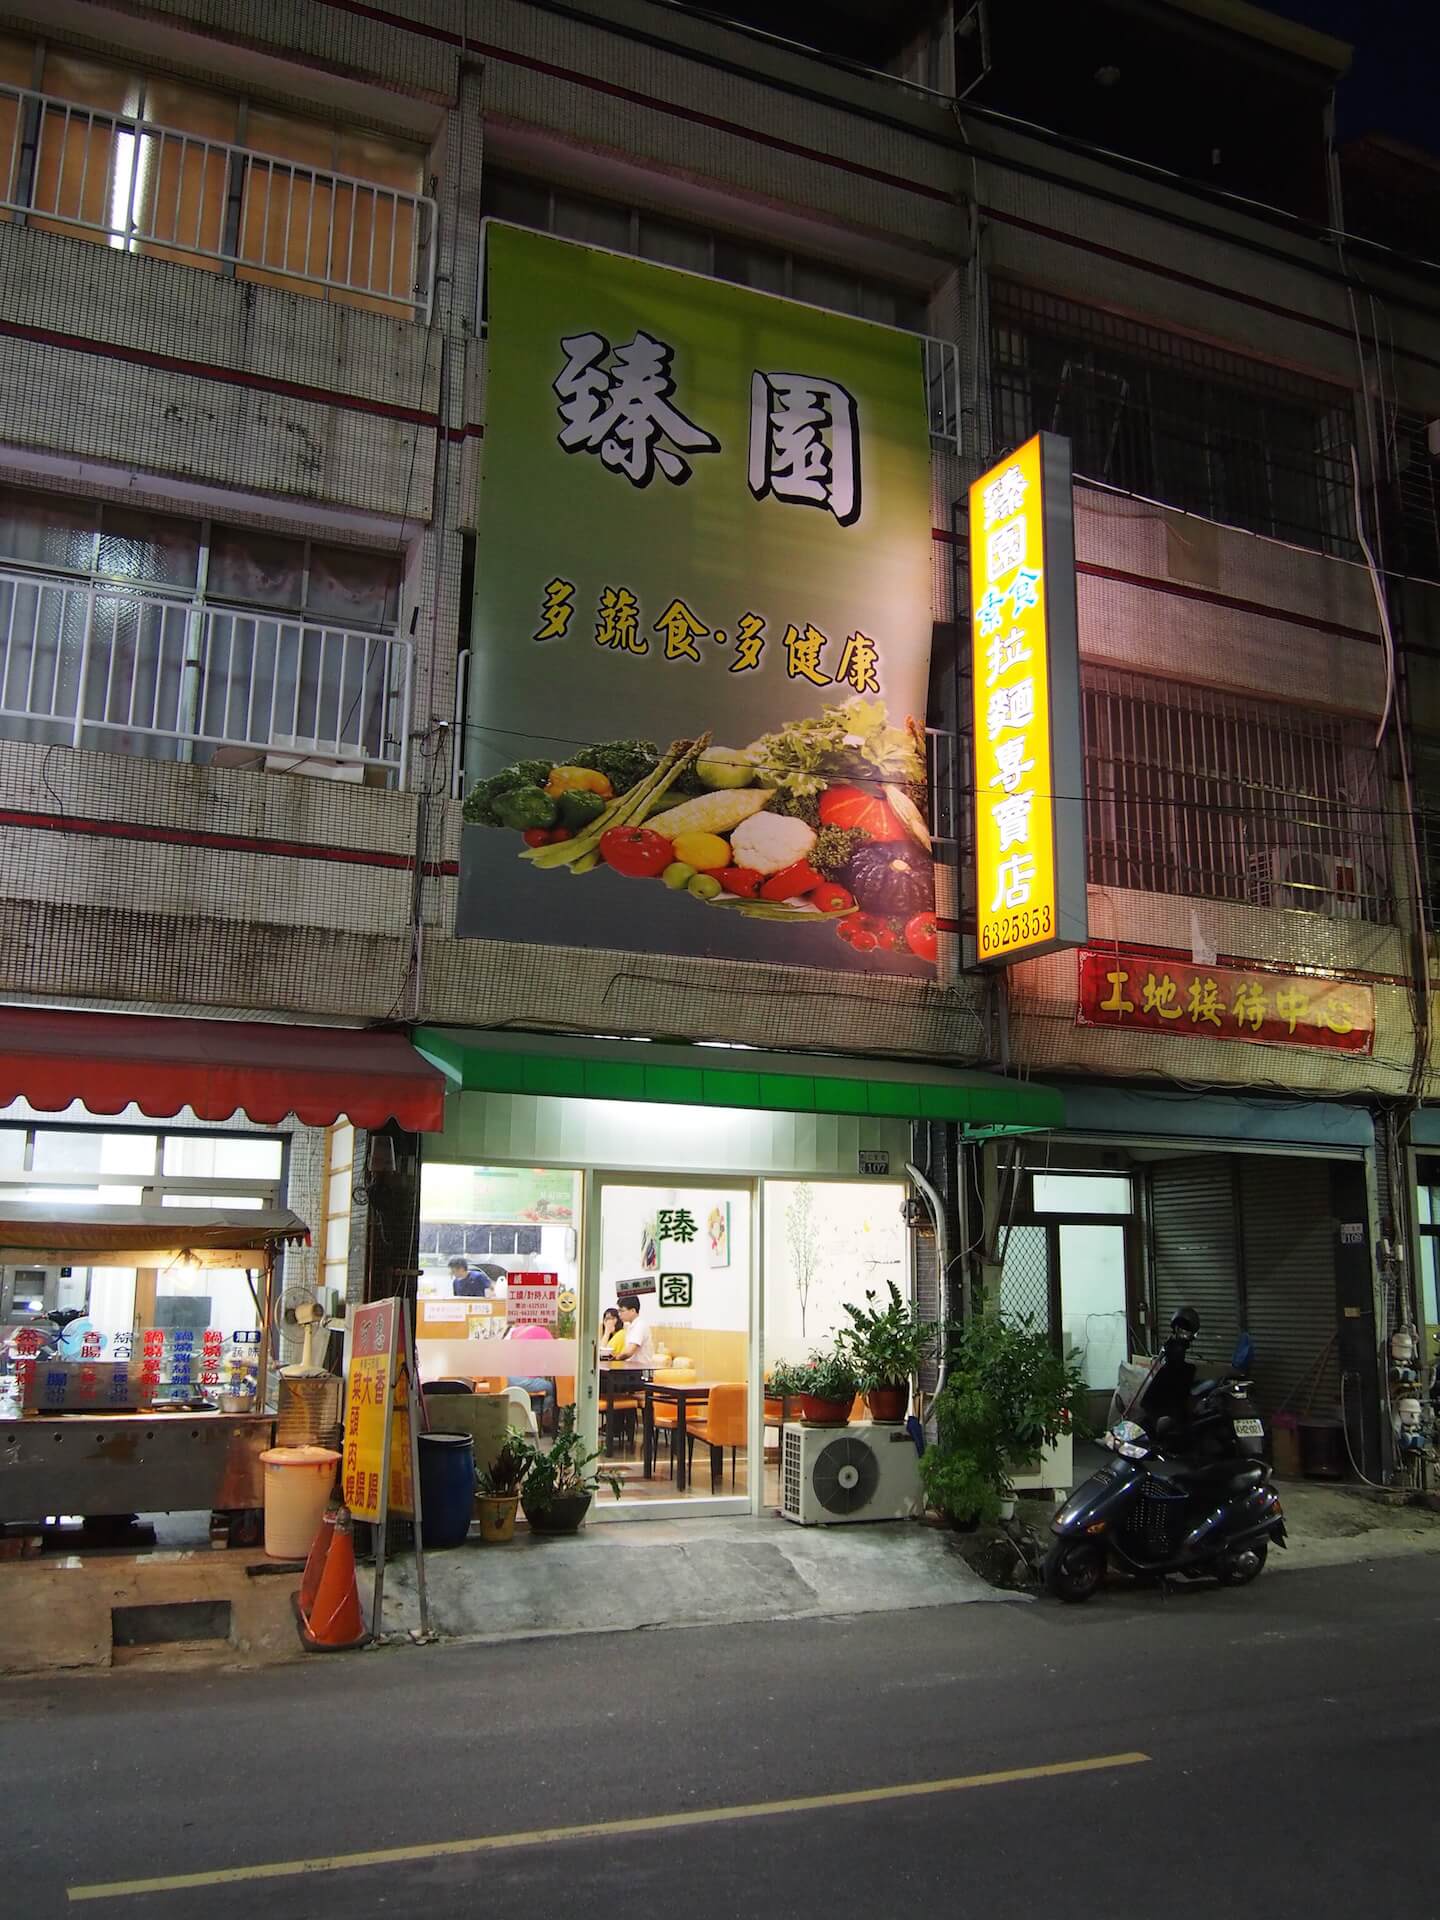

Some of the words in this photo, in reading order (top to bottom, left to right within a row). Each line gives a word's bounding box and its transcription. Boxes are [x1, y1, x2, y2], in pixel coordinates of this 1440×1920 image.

[552, 329, 862, 526] 臻園
[983, 904, 1051, 951] 6325353
[1100, 971, 1353, 1034] 工地接待中心
